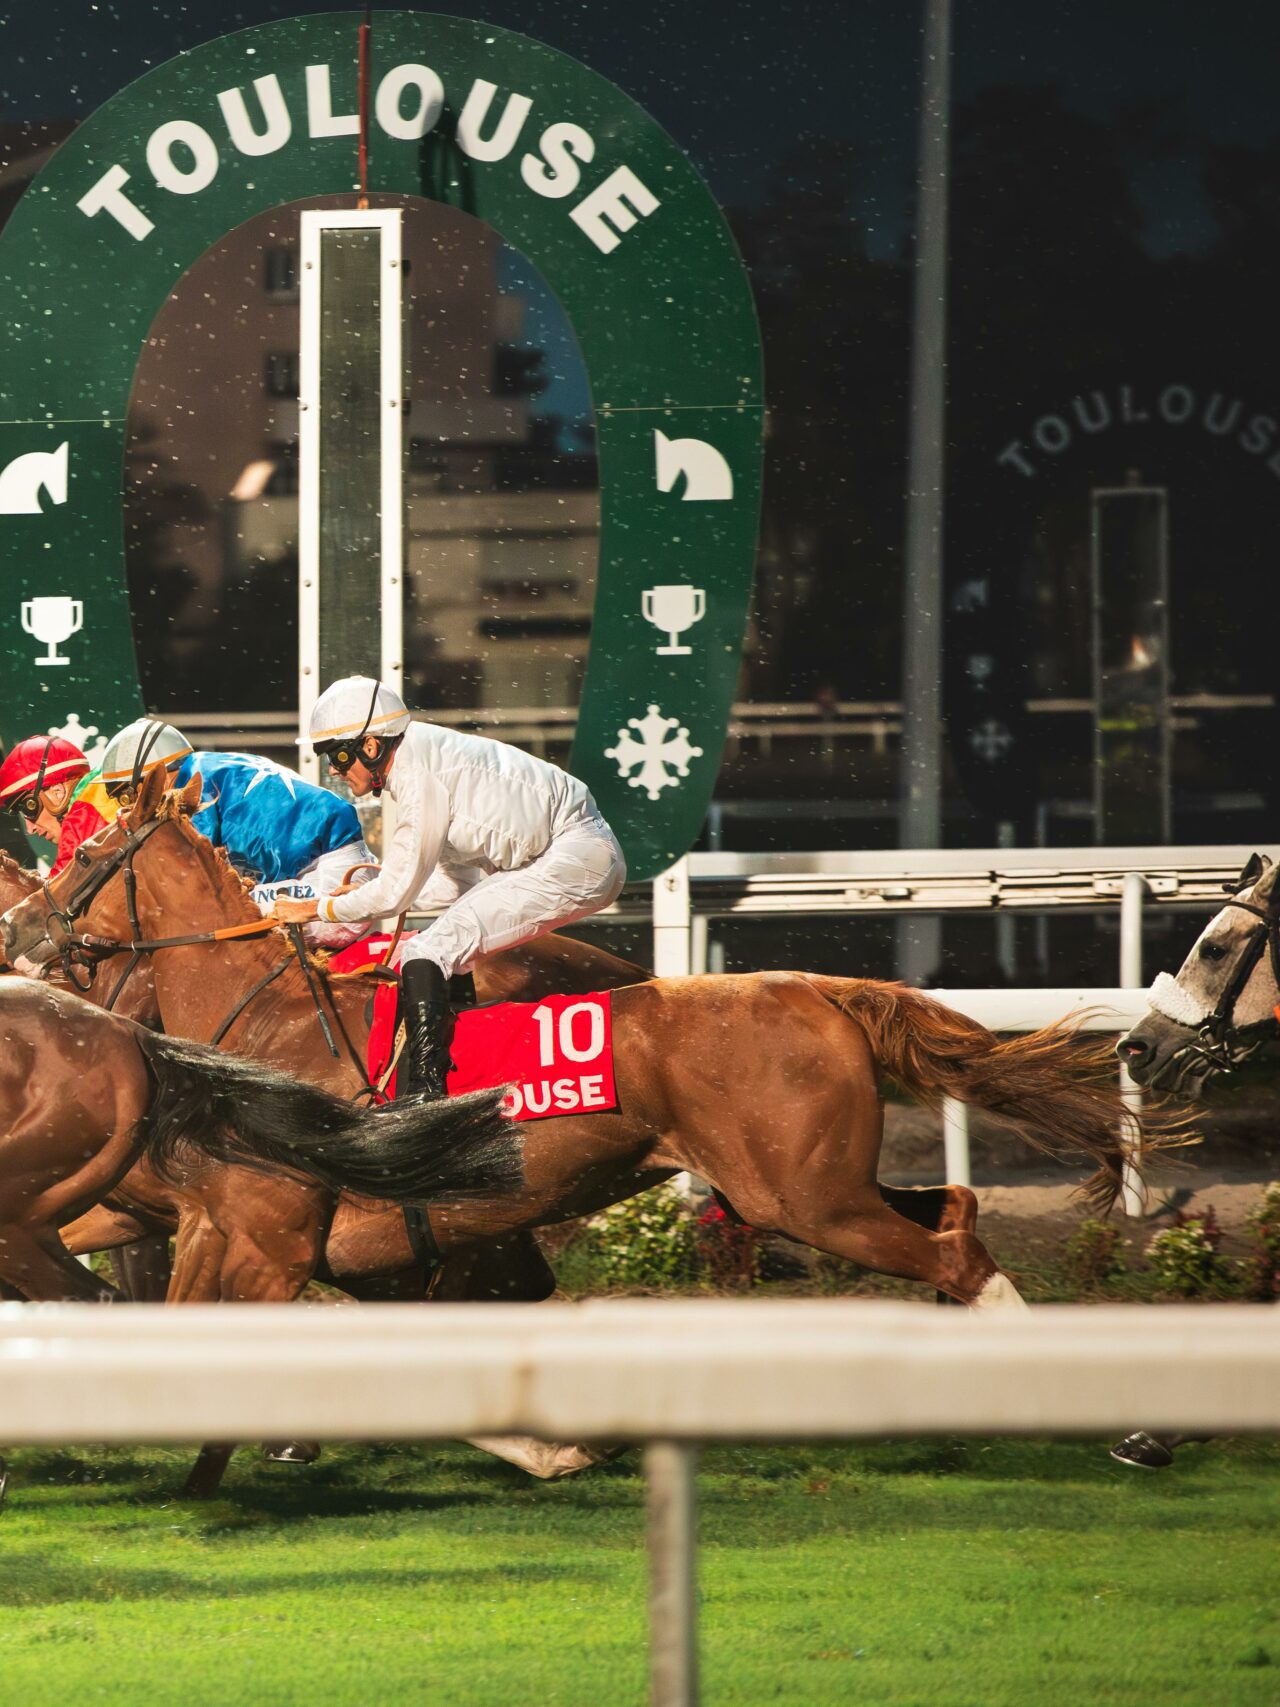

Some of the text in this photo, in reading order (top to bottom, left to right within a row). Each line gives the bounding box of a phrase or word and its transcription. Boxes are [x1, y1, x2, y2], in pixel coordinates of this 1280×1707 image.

[75, 63, 662, 255] TOULOUSE
[996, 384, 1280, 480] TOULOUS
[531, 1002, 605, 1068] 10
